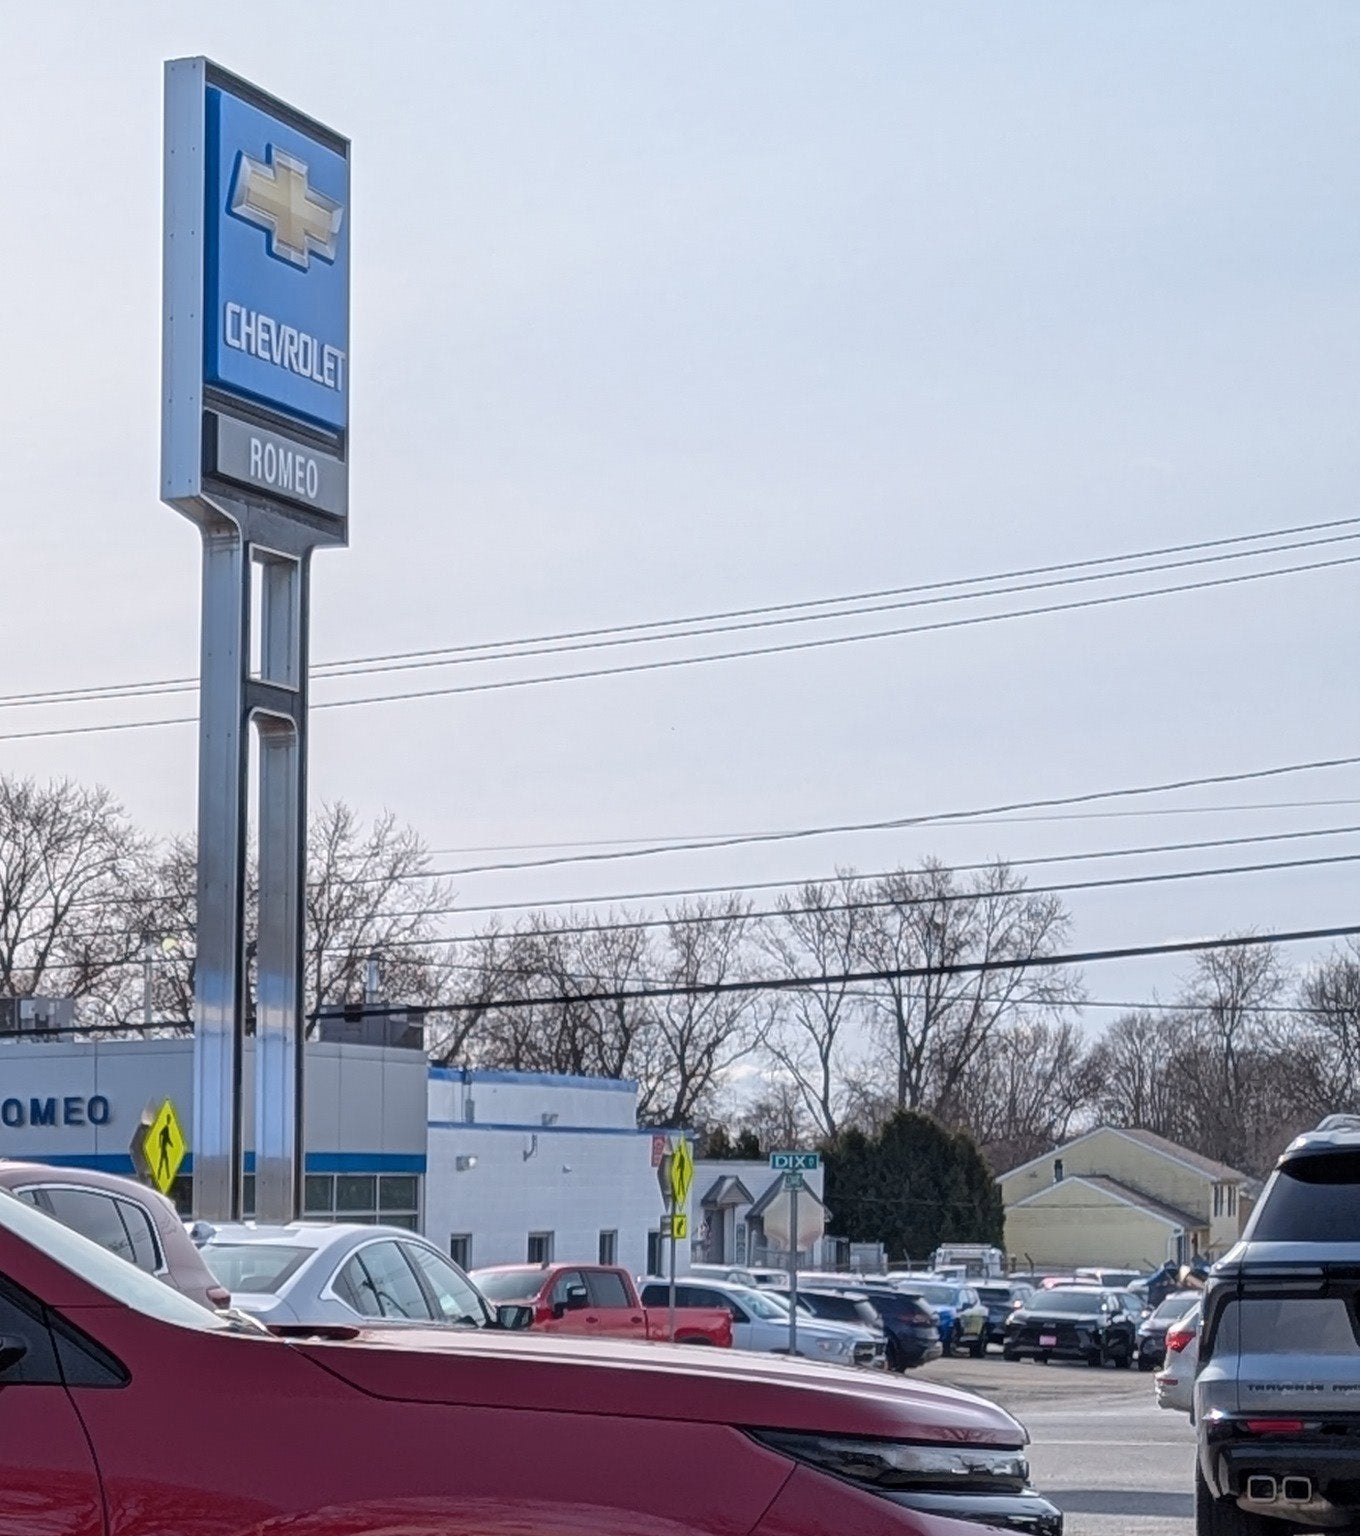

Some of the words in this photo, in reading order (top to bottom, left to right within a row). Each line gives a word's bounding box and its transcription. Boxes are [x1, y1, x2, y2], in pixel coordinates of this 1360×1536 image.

[224, 300, 345, 391] CHEVROLET
[249, 436, 319, 500] ROMEO
[775, 1155, 806, 1168] DIX
